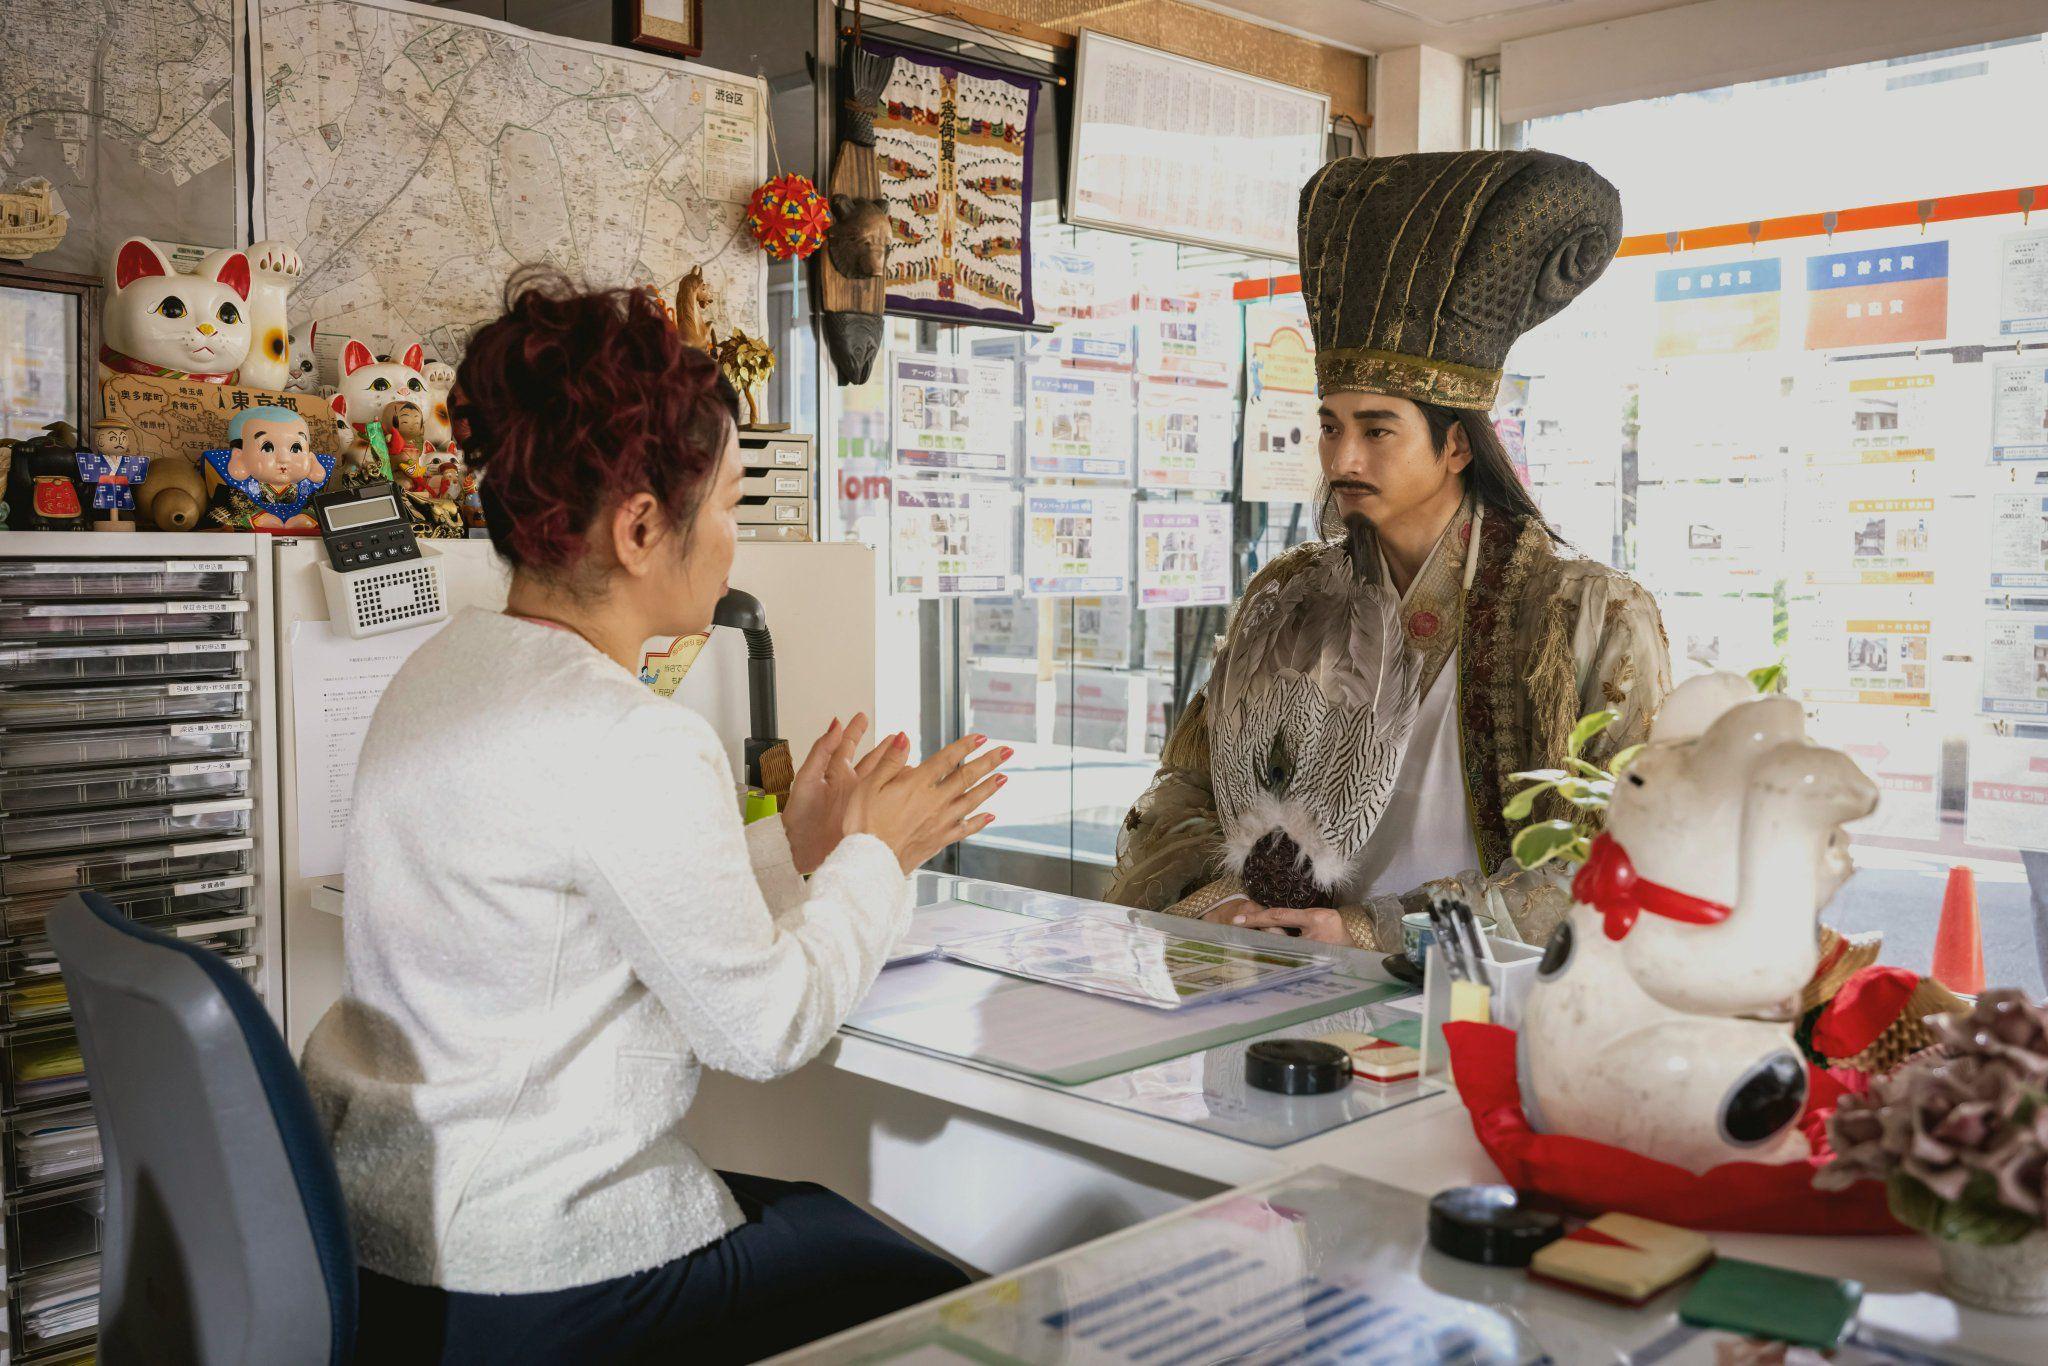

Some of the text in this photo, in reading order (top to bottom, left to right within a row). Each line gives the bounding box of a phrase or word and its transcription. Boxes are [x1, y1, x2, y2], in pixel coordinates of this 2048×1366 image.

[715, 88, 743, 106] 渋谷区
[121, 390, 164, 403] 奥多摩町
[179, 386, 204, 397] 埼玉県
[172, 400, 198, 411] 青梅市
[139, 421, 166, 430] 檜原村
[182, 441, 215, 451] 八王子市
